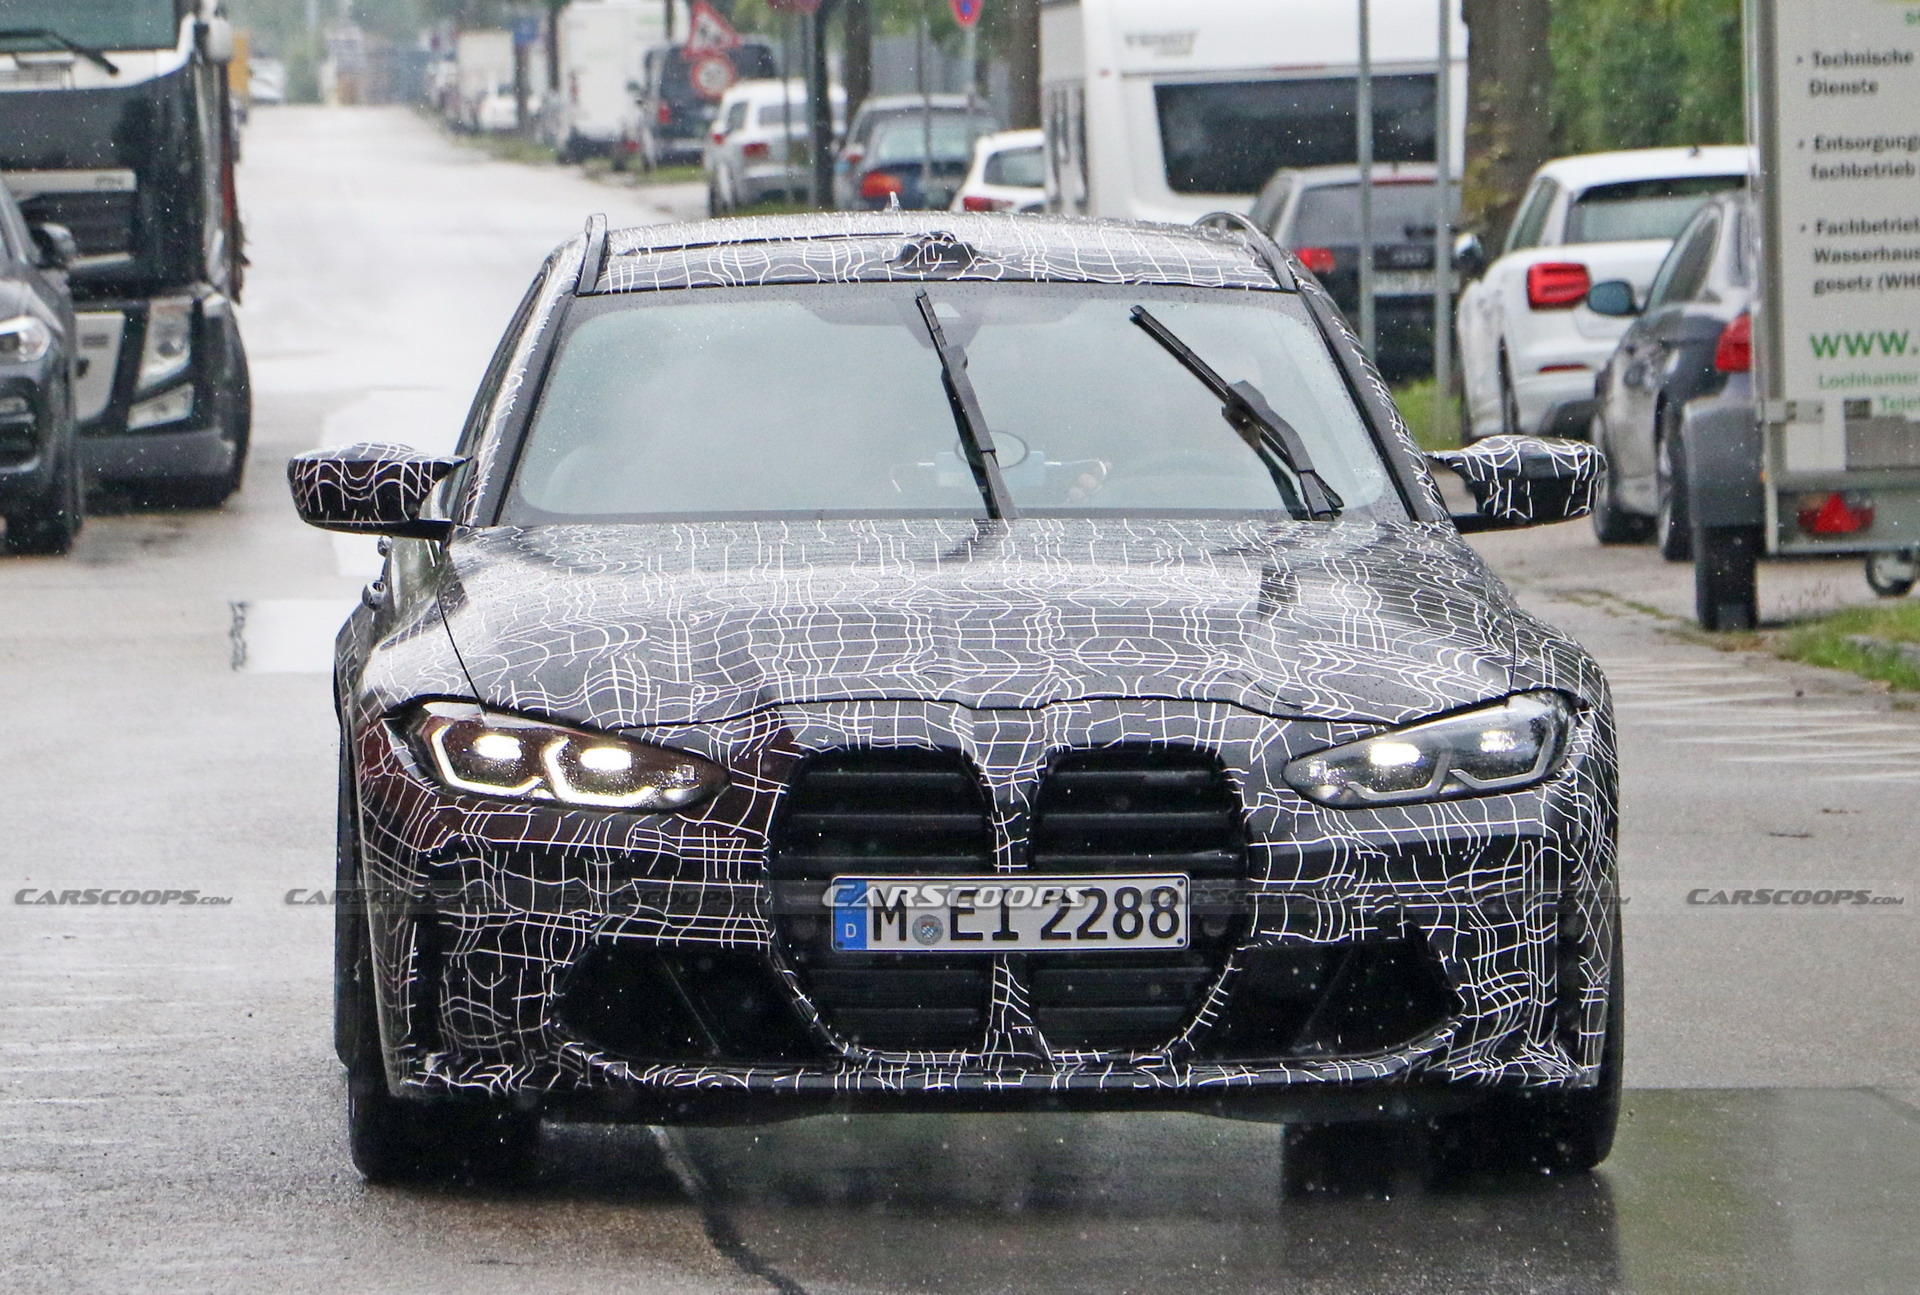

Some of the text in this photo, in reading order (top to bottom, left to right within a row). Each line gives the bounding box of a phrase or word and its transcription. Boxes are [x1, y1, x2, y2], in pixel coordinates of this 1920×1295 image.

[1812, 49, 1915, 68] Technische
[1810, 78, 1879, 97] Dienste
[1811, 161, 1916, 180] fachbetrieb
[1814, 270, 1920, 297] gesetz (WH
[1810, 328, 1919, 358] www.
[1881, 395, 1920, 411] Tele
[873, 887, 907, 942] M
[1040, 885, 1181, 941] 2288
[845, 923, 857, 938] D
